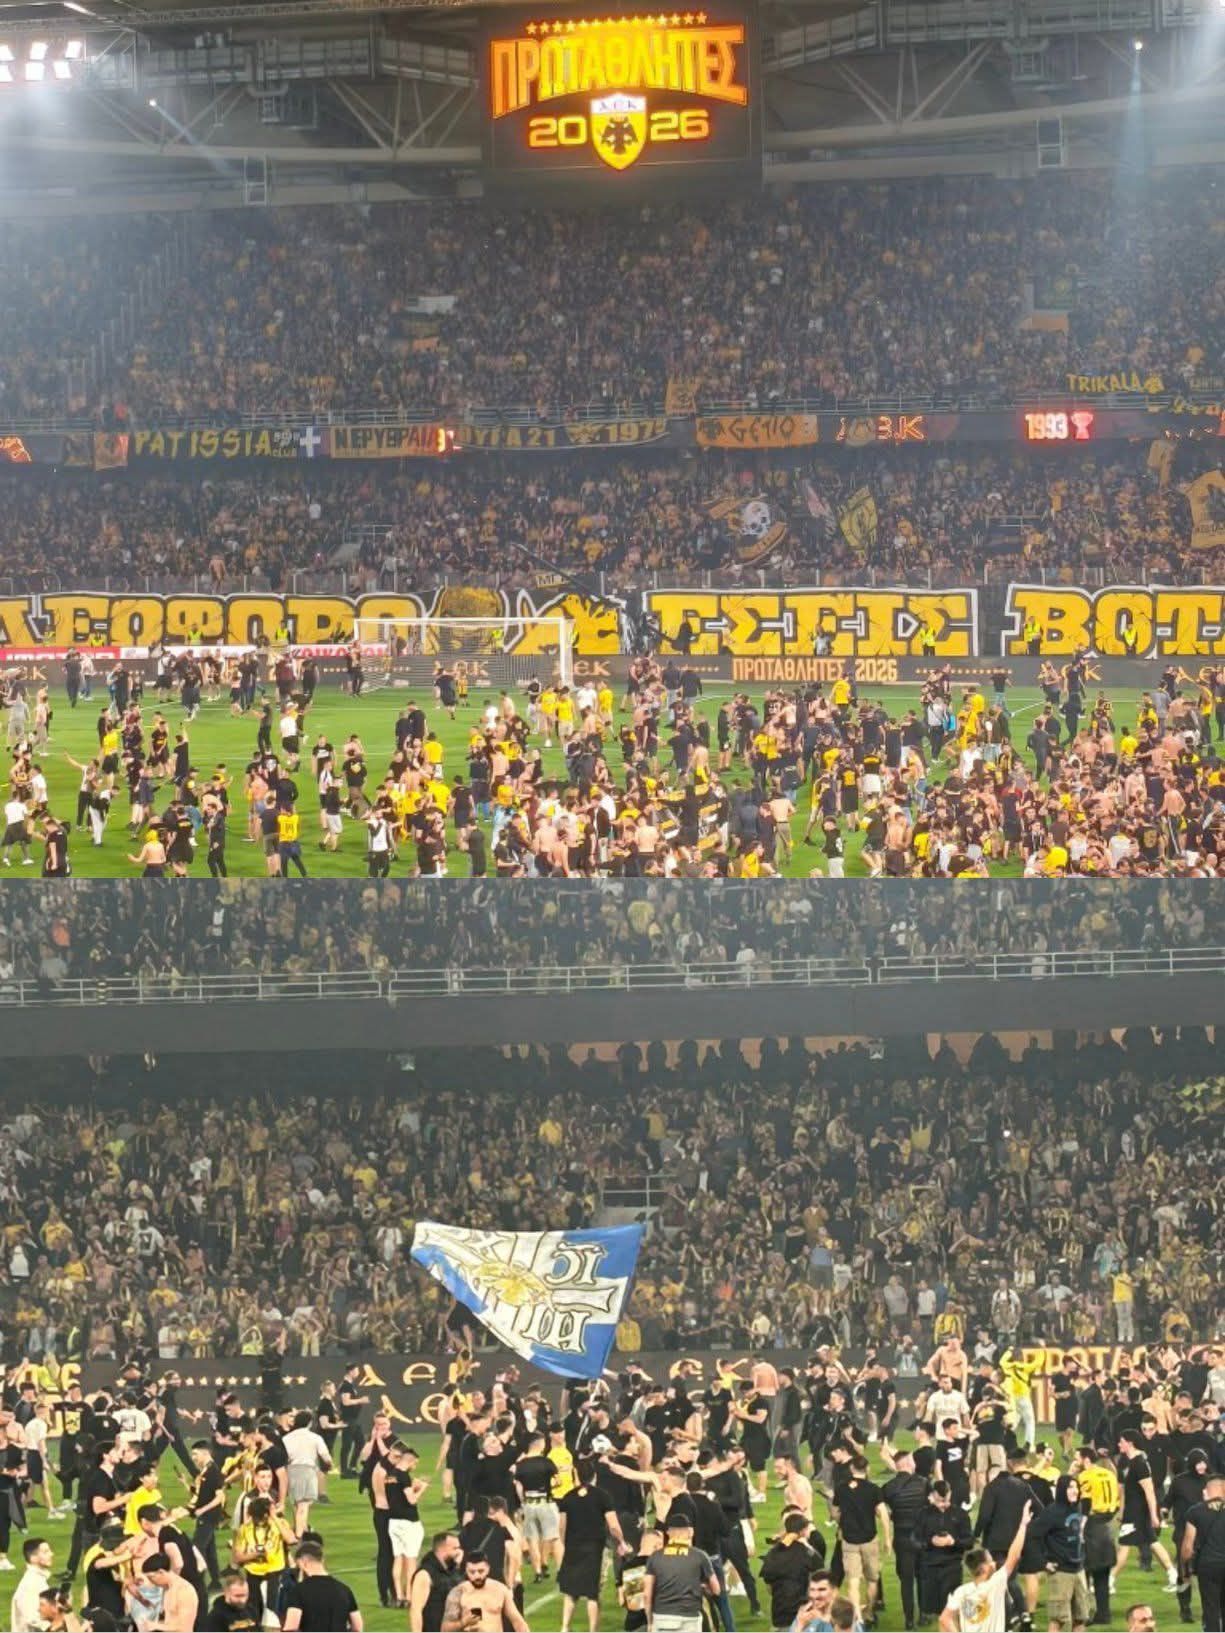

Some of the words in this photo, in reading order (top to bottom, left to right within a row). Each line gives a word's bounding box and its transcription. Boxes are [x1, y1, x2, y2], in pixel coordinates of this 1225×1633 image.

[491, 24, 747, 118] ΠΡΩΤΑΘΛΗΤΕΣ
[529, 115, 588, 147] 20
[650, 109, 710, 141] 26
[134, 429, 272, 459] PATISSIA
[733, 658, 847, 681] ΠΡΩΤΑΘΛΗΤΕΣ
[855, 658, 898, 681] 2026
